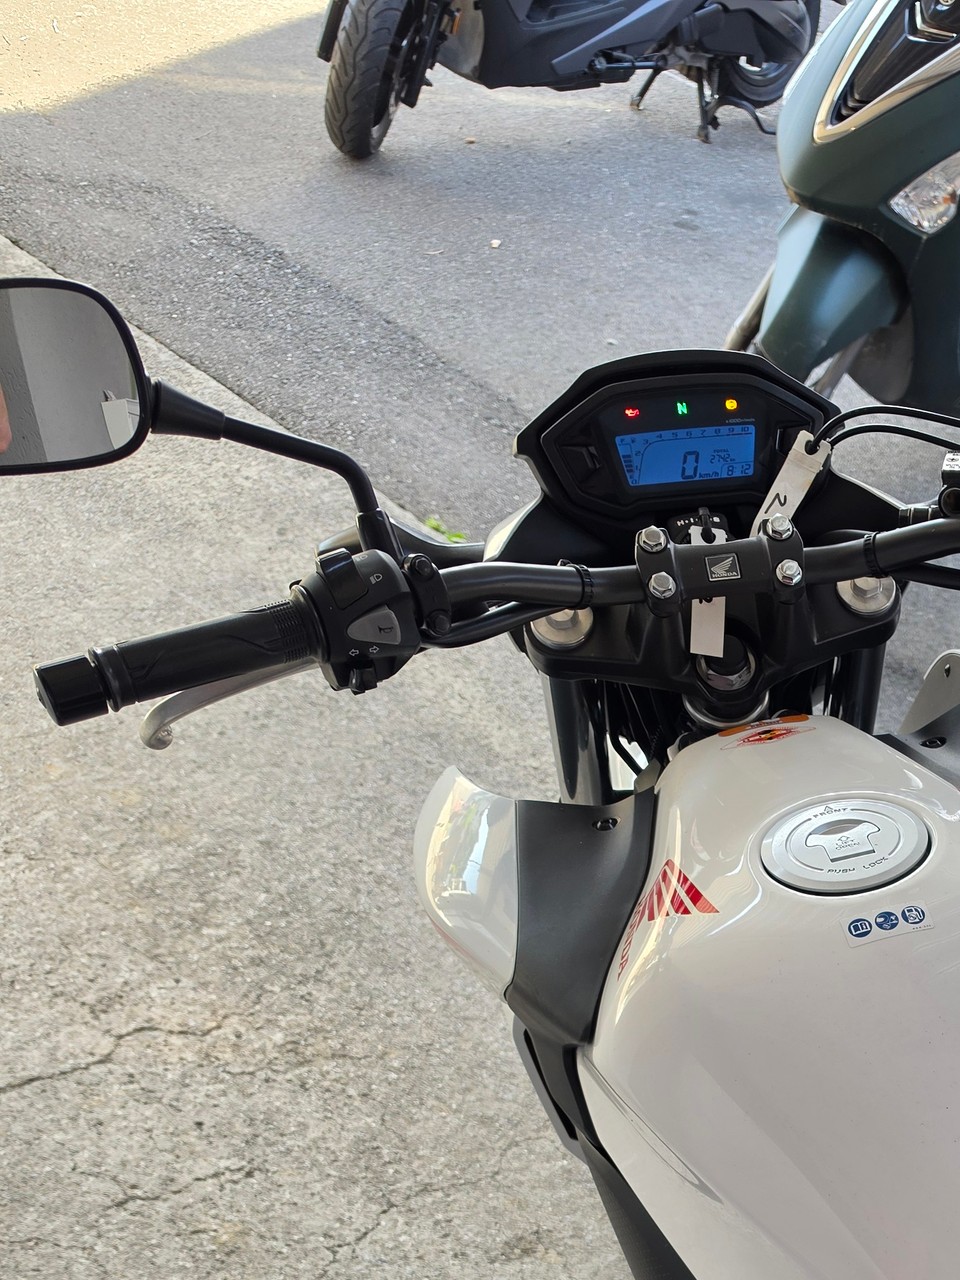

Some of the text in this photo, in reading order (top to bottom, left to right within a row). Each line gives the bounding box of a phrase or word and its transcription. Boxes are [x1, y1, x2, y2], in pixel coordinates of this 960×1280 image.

[677, 402, 688, 415] N
[681, 450, 720, 480] 0 km/h
[710, 453, 731, 464] 2742
[727, 463, 751, 476] 8:12
[812, 807, 848, 818] FRONT
[835, 842, 860, 850] OPEN
[862, 856, 889, 870] LOCK
